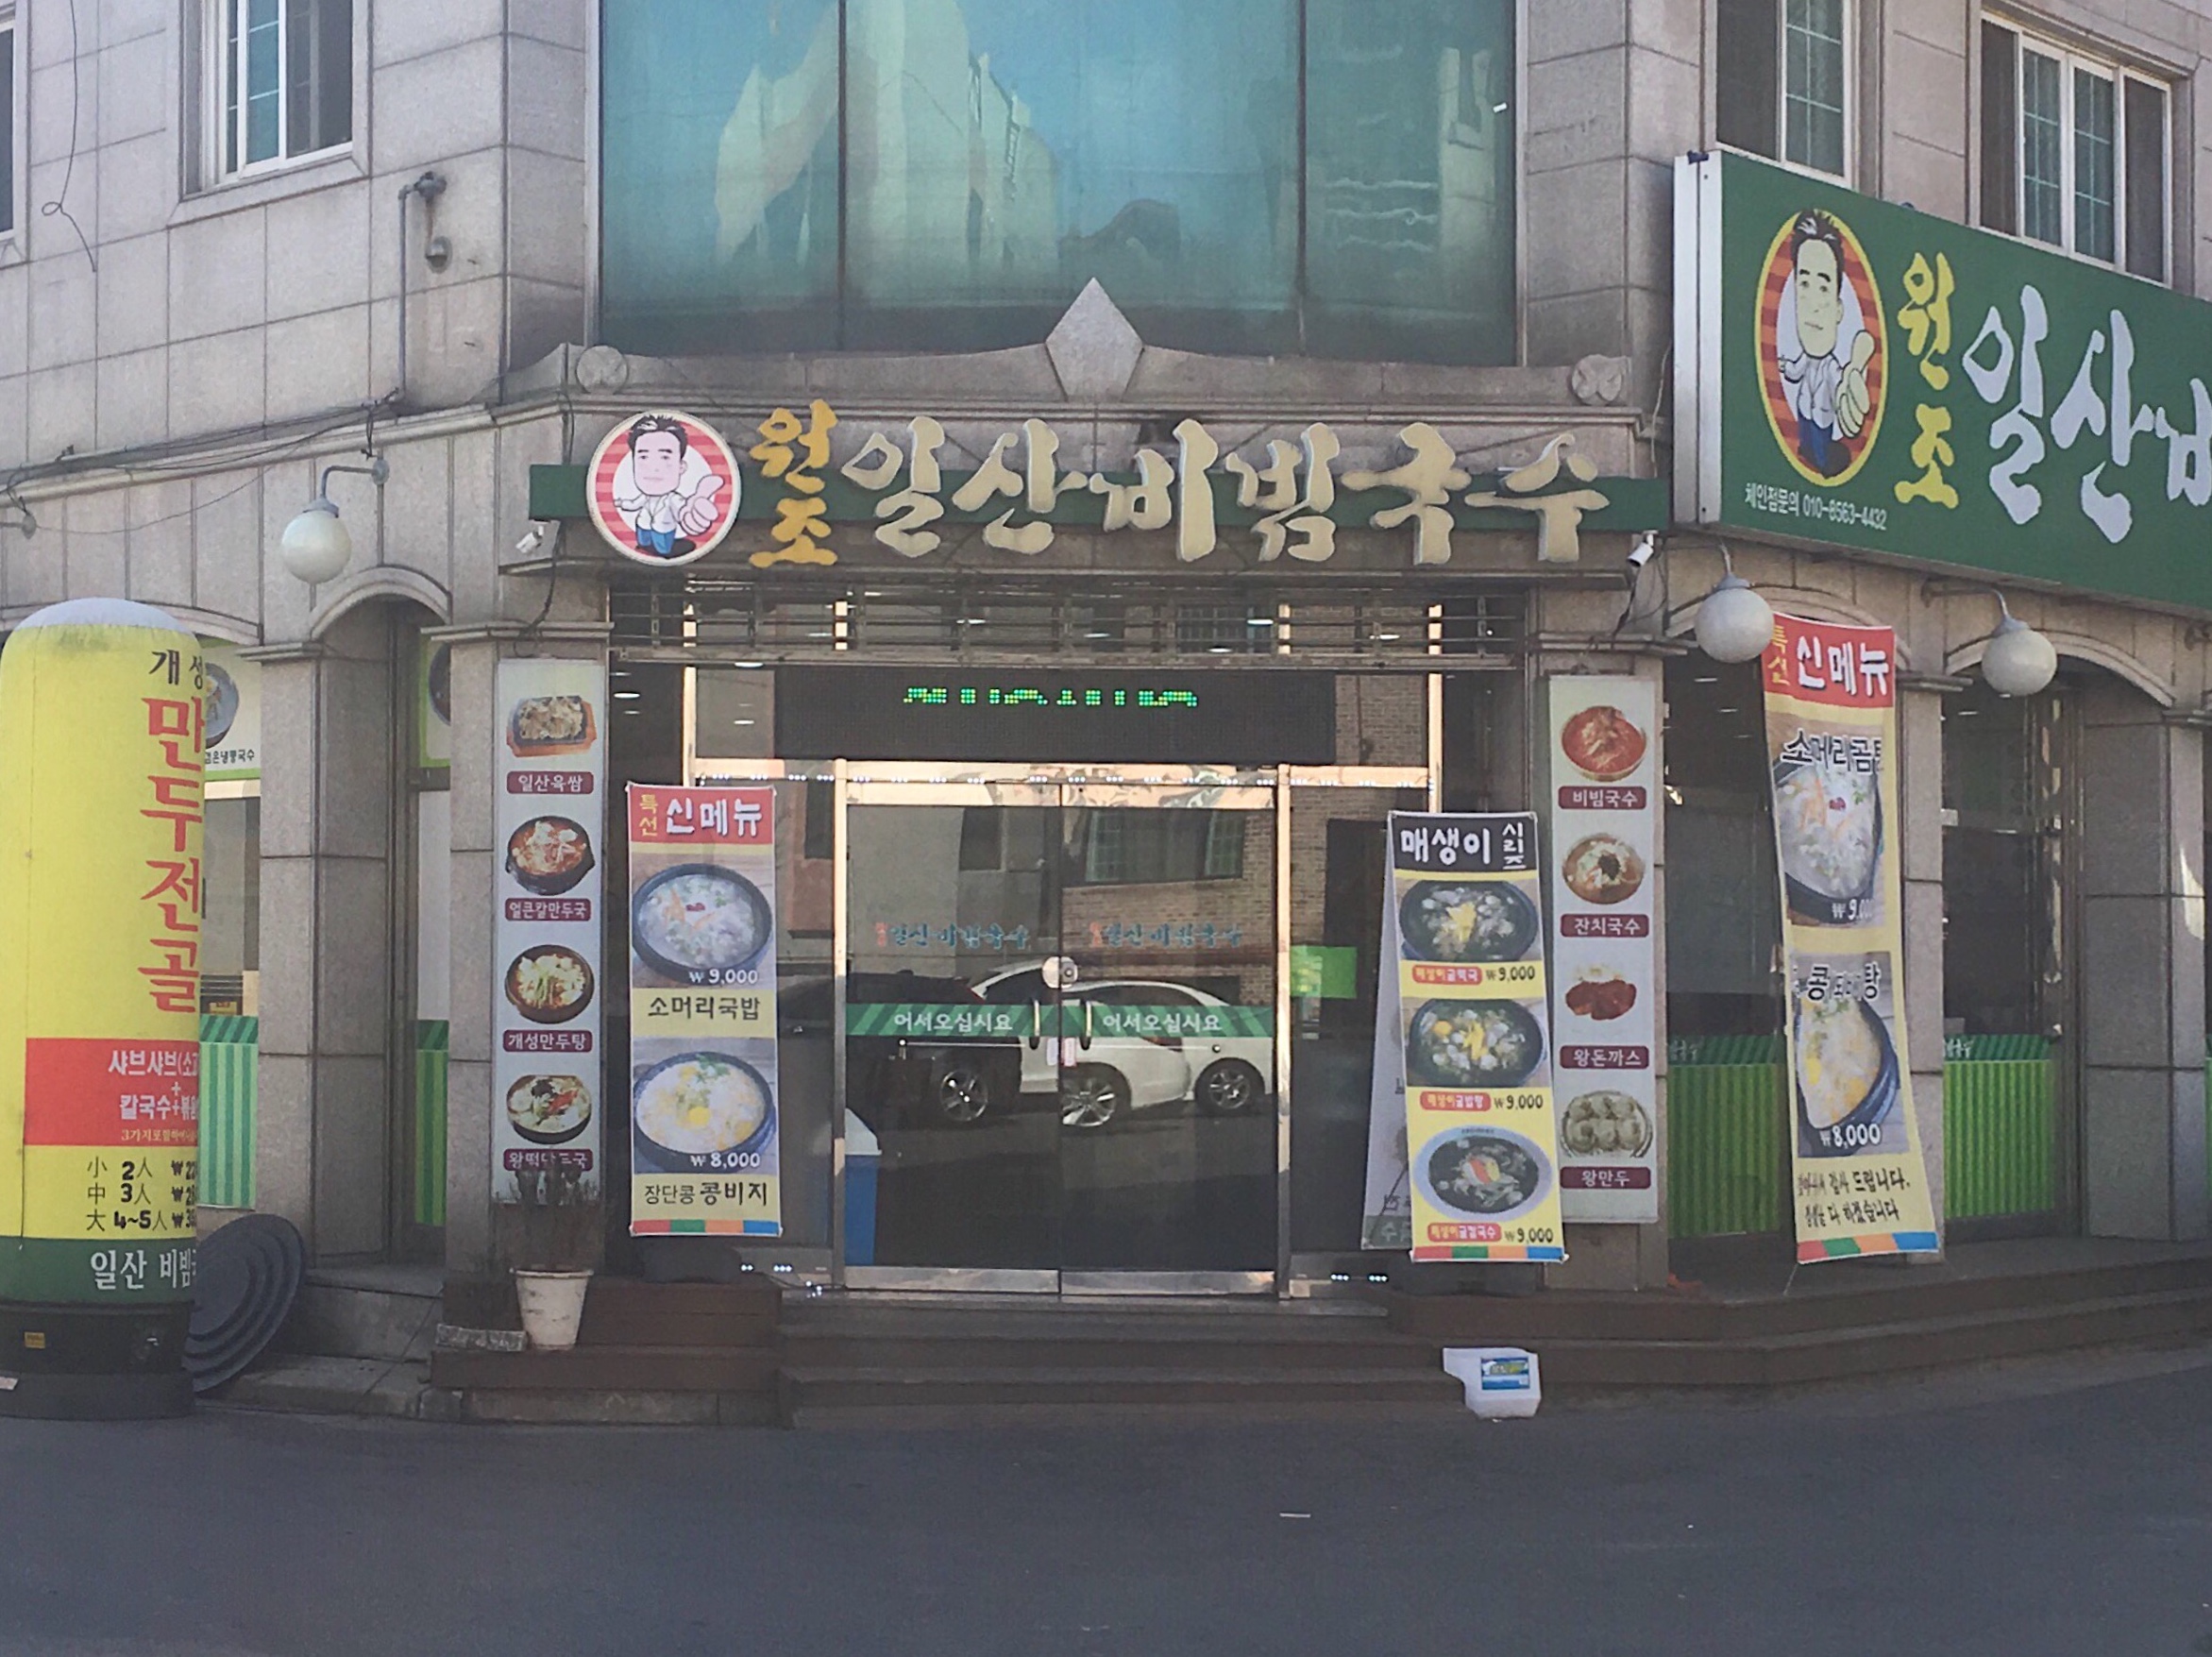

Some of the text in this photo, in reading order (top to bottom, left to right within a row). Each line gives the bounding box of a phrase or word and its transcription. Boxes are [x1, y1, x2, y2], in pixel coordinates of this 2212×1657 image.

[1894, 252, 1959, 509] 원조
[750, 399, 836, 567] 원조
[1745, 482, 1799, 516] 체인점문의
[148, 649, 204, 690] 개성
[1797, 635, 1889, 697] 신메뉴
[1573, 789, 1638, 808] 비빔국수
[639, 794, 658, 837] 특선
[667, 798, 762, 837] 신메뉴
[140, 696, 205, 1013] 만두전골
[1400, 827, 1490, 865] 매생이
[1502, 822, 1527, 870] 시리즈
[1574, 918, 1641, 936] 잔치국수
[649, 996, 760, 1020] 소머리국밥
[894, 1011, 1013, 1032] 어서오십시요
[1103, 1012, 1223, 1033] 어서오십시요
[508, 1033, 587, 1050] 개성만두탕
[1574, 1048, 1642, 1067] 왕돈까스
[88, 1182, 105, 1205] 中
[1581, 1169, 1630, 1188] 왕만두
[645, 1181, 767, 1207] 장단콩 콩비지
[86, 1209, 106, 1231] 大
[90, 1249, 147, 1290] 일산
